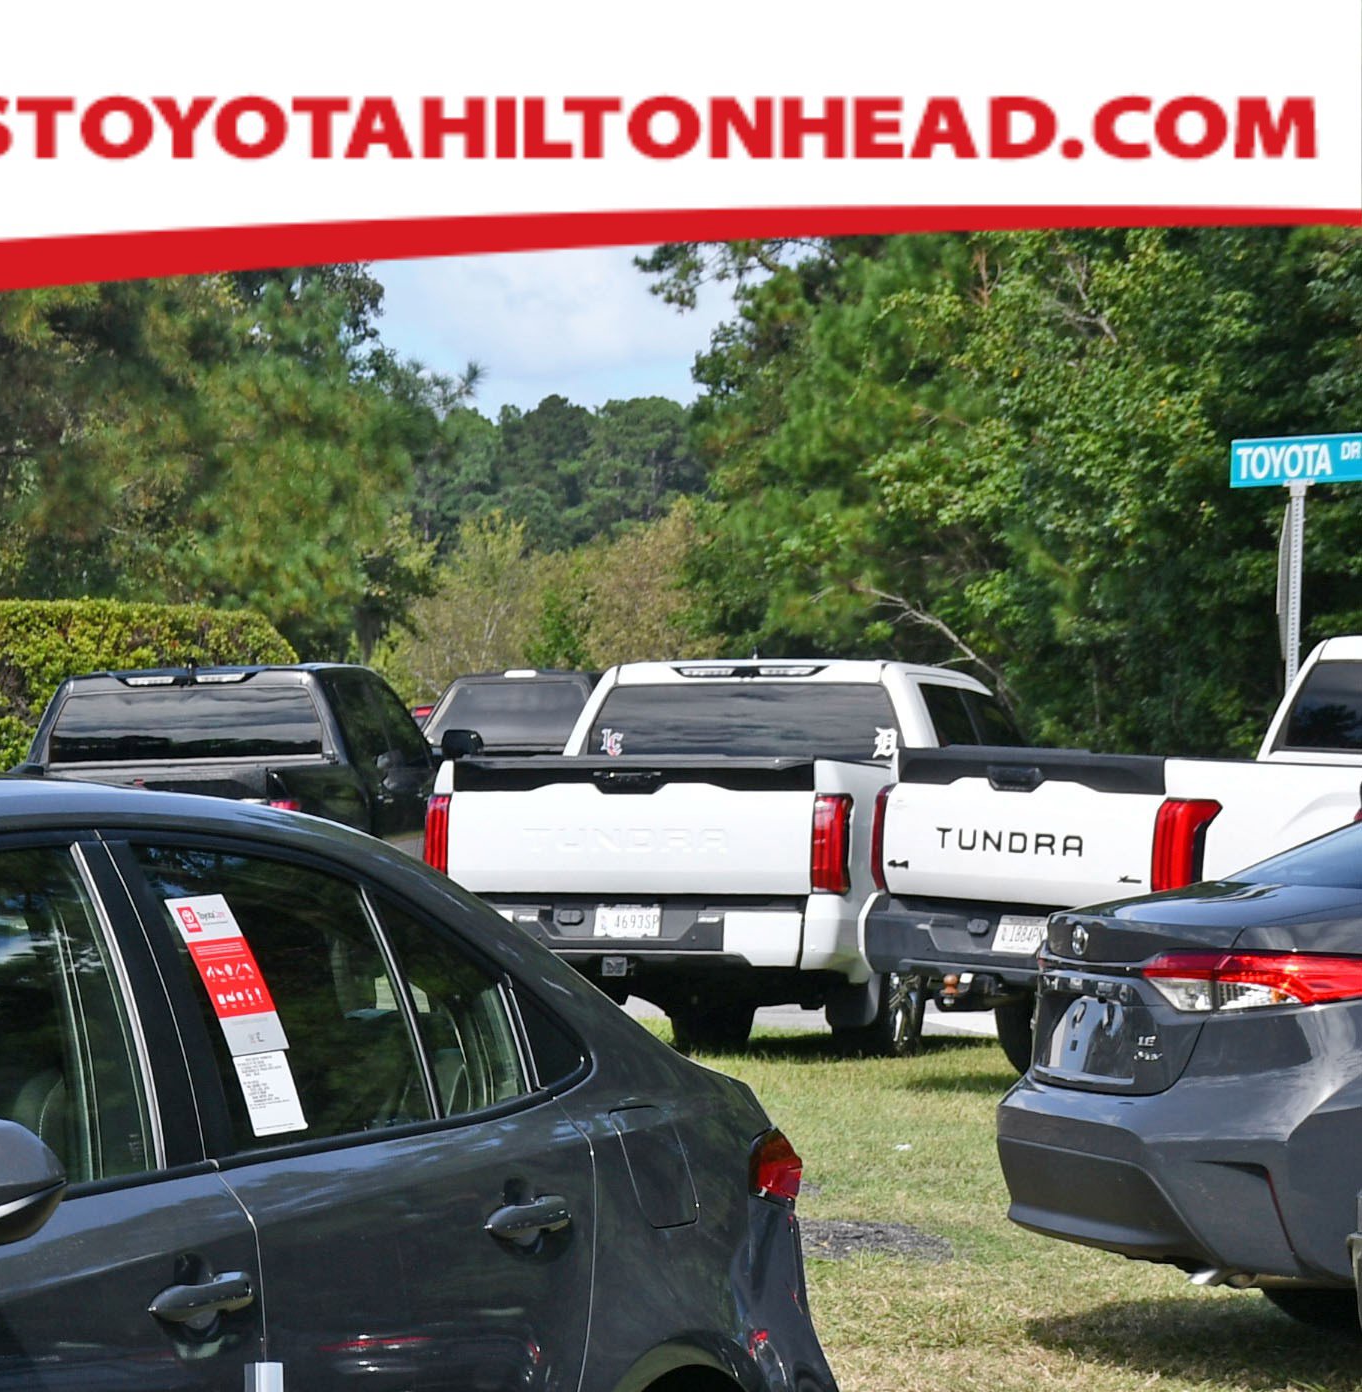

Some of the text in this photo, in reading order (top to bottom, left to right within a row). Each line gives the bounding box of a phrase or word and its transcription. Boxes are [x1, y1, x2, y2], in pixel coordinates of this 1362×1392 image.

[1236, 443, 1333, 480] TOYOTA
[522, 828, 728, 853] TUNDRA
[935, 827, 1083, 857] TUNDRA
